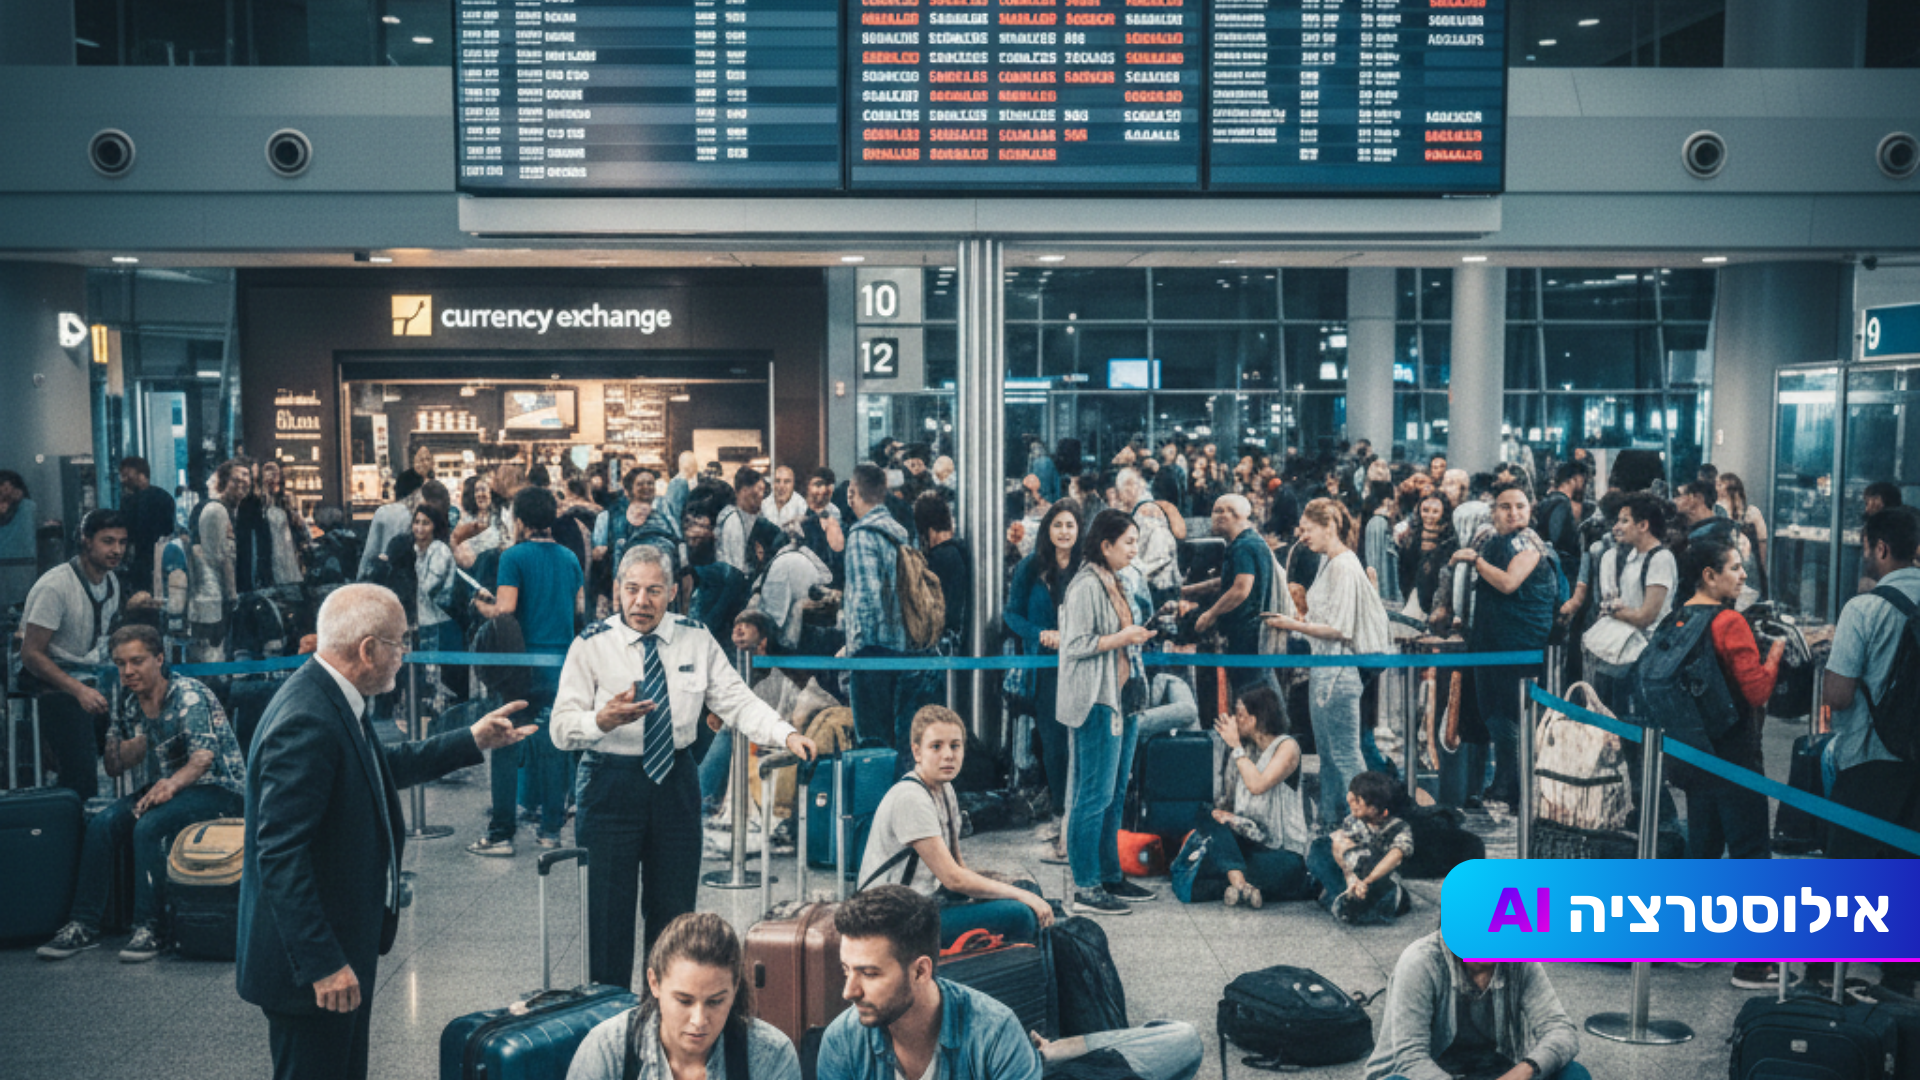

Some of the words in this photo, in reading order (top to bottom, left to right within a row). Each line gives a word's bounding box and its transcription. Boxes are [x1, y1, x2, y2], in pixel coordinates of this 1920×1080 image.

[861, 284, 896, 316] 10
[440, 307, 553, 335] currency
[556, 303, 672, 335] exchange
[1867, 316, 1881, 350] 9
[861, 341, 893, 373] 12
